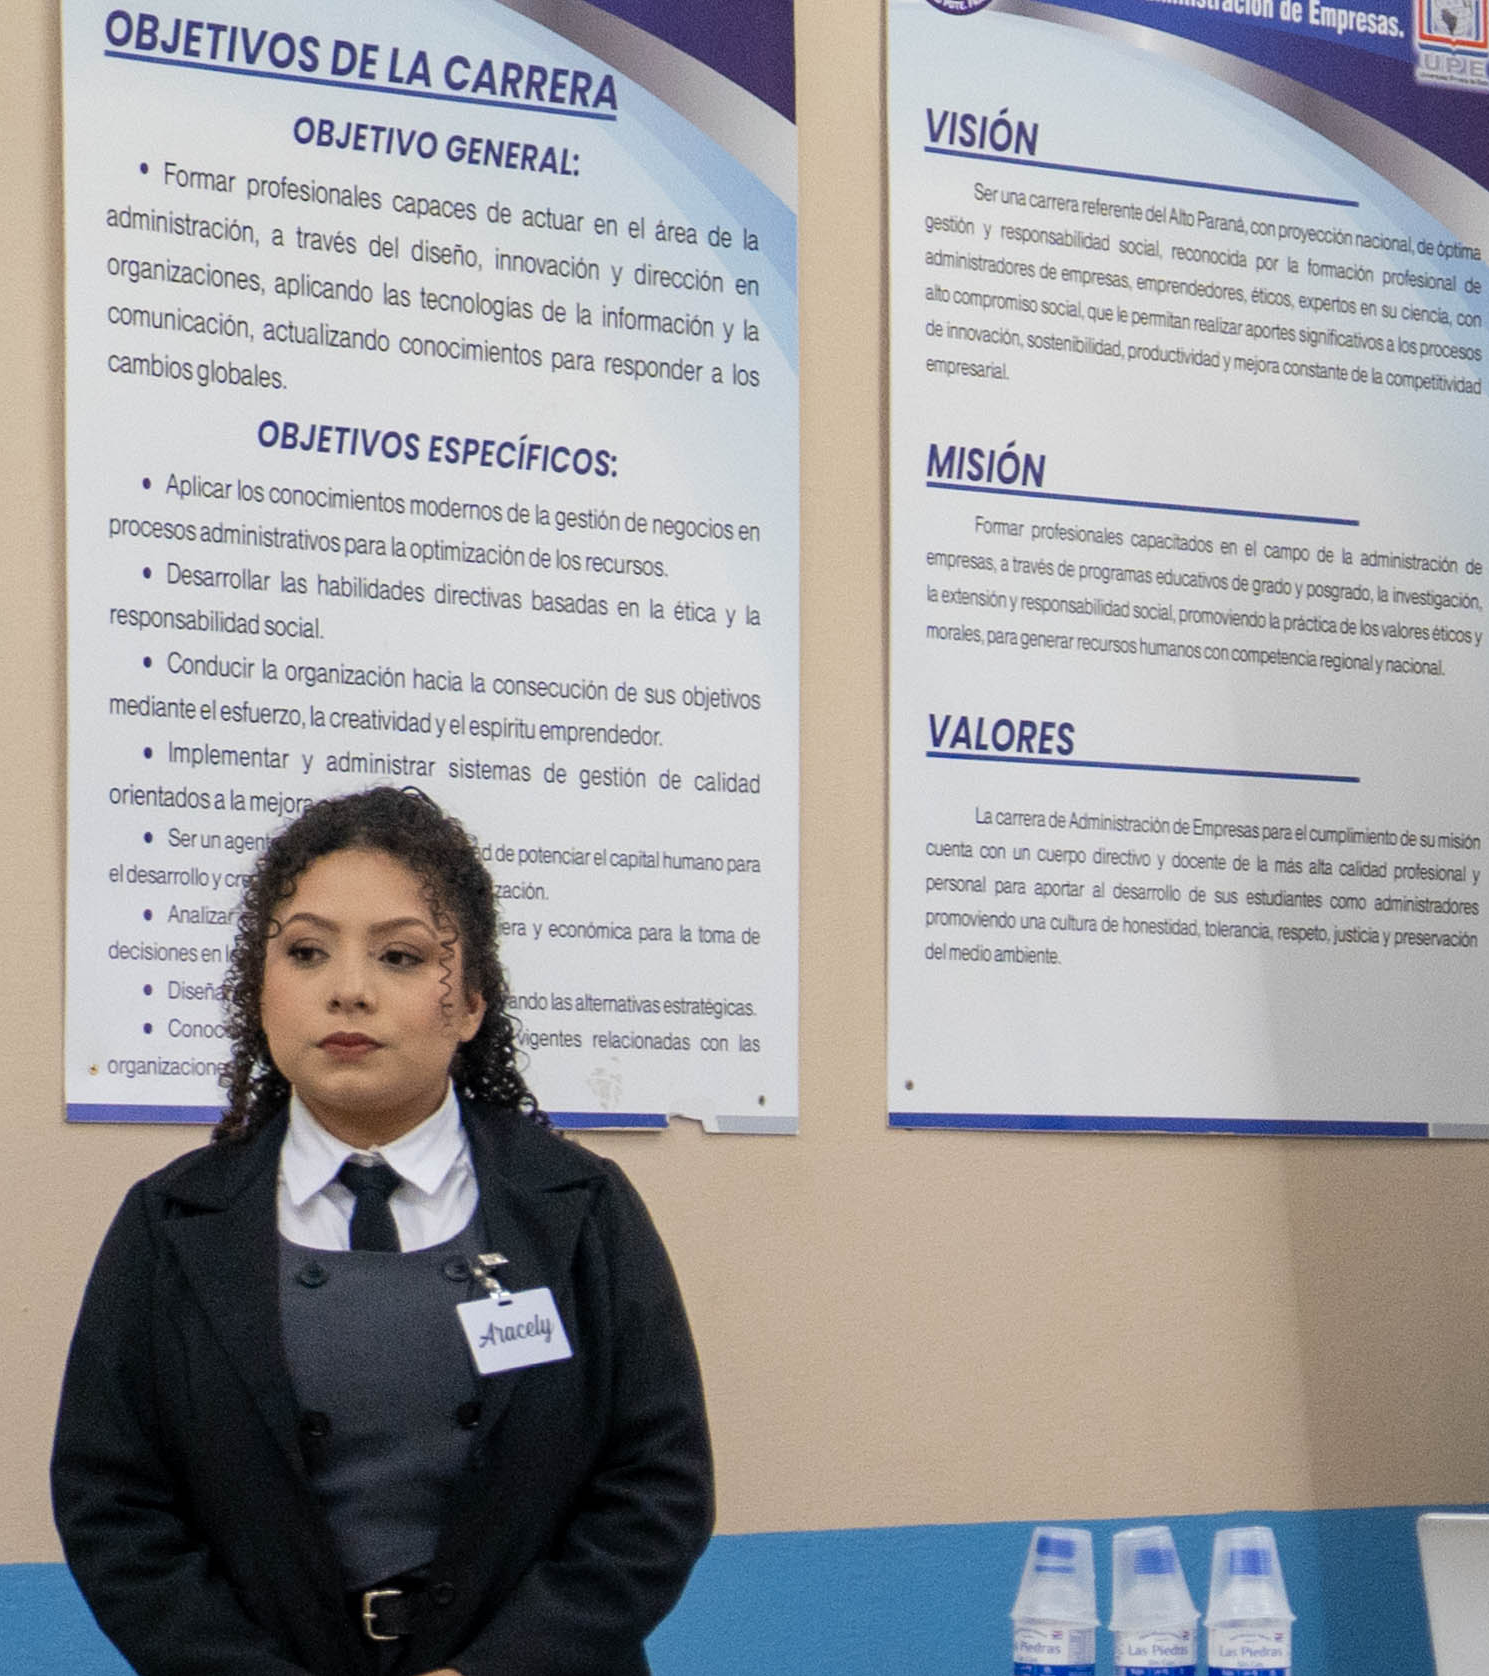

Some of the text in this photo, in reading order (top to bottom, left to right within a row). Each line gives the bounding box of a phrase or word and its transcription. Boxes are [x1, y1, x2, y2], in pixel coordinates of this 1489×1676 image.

[1279, 3, 1302, 23] de
[1309, 0, 1405, 37] Empresas.
[106, 9, 617, 110] OBJETIVOS DE LA CARRERA
[294, 116, 579, 177] OBJETIVO GENERAL:
[925, 107, 1039, 156] VISIÓN
[164, 161, 759, 252] Formar profesionales capaces de actuar en el área de la
[925, 215, 1482, 295] gestión y responsabilidad social, reconocida por la formación profesional de
[258, 420, 617, 478] OBJETIVOS ESPECÍFICOS:
[926, 440, 1046, 488] MISIÓN
[928, 713, 1076, 757] VALORES
[169, 741, 760, 795] Implementar y administrar sistemas de gestión de calidad
[926, 876, 1479, 916] personal para aportar al desarrollo de sus estudiantes como administradores
[478, 1314, 553, 1348] Aracely
